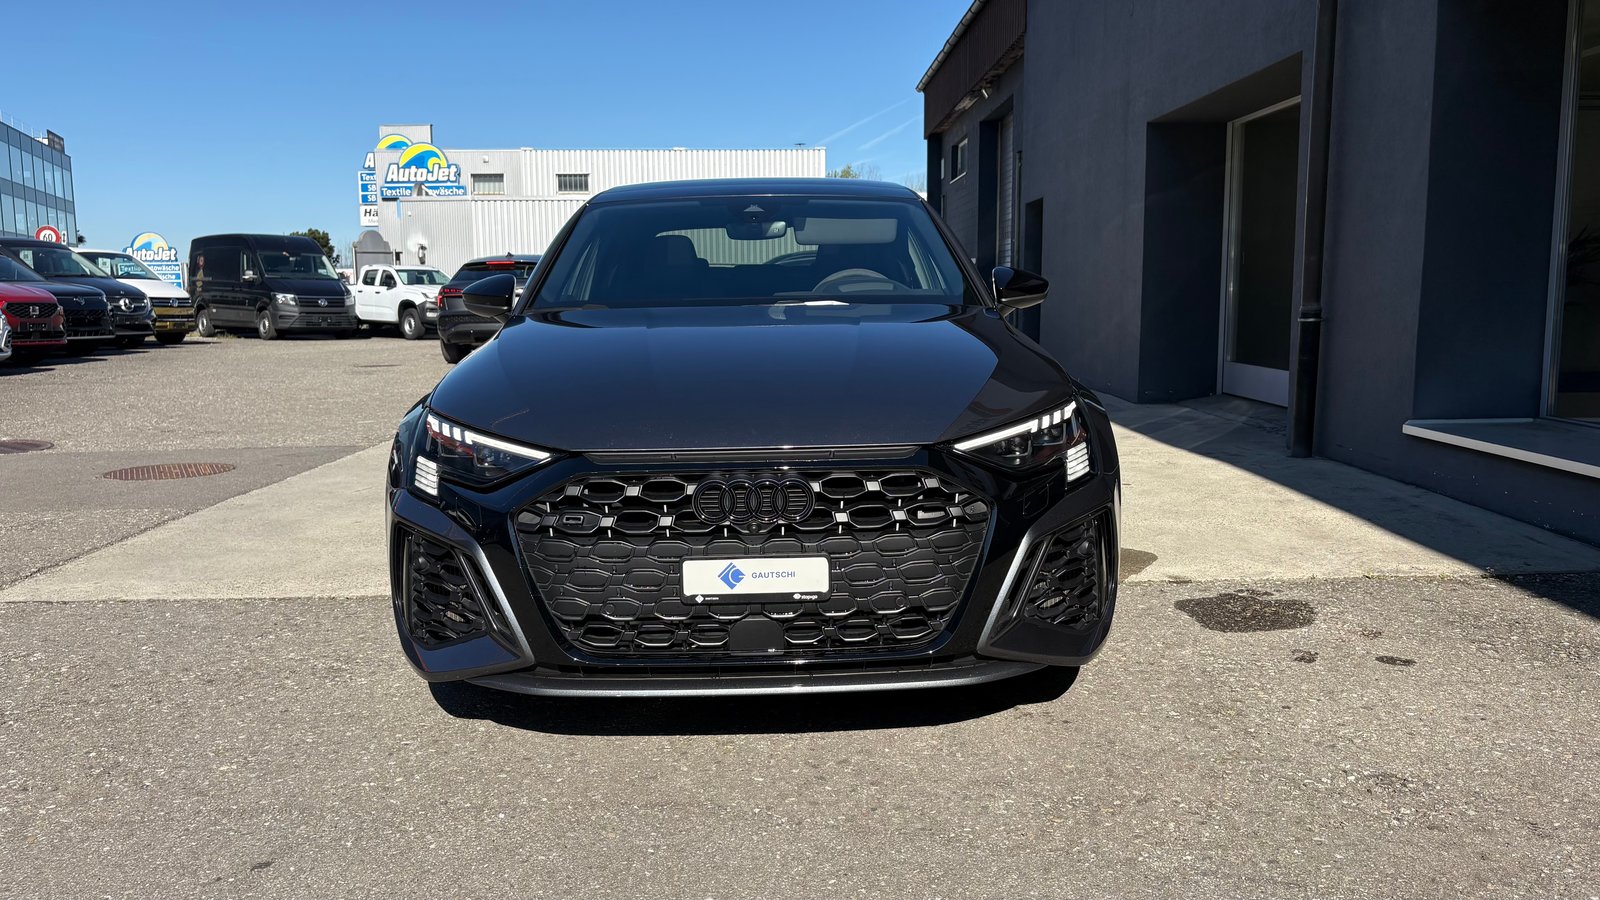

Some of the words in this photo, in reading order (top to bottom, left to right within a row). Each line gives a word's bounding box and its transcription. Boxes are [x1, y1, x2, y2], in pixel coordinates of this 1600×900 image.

[386, 163, 459, 182] AutoJet
[381, 187, 411, 196] Textile
[43, 233, 53, 242] 60
[751, 571, 796, 579] GAUTSCHI
